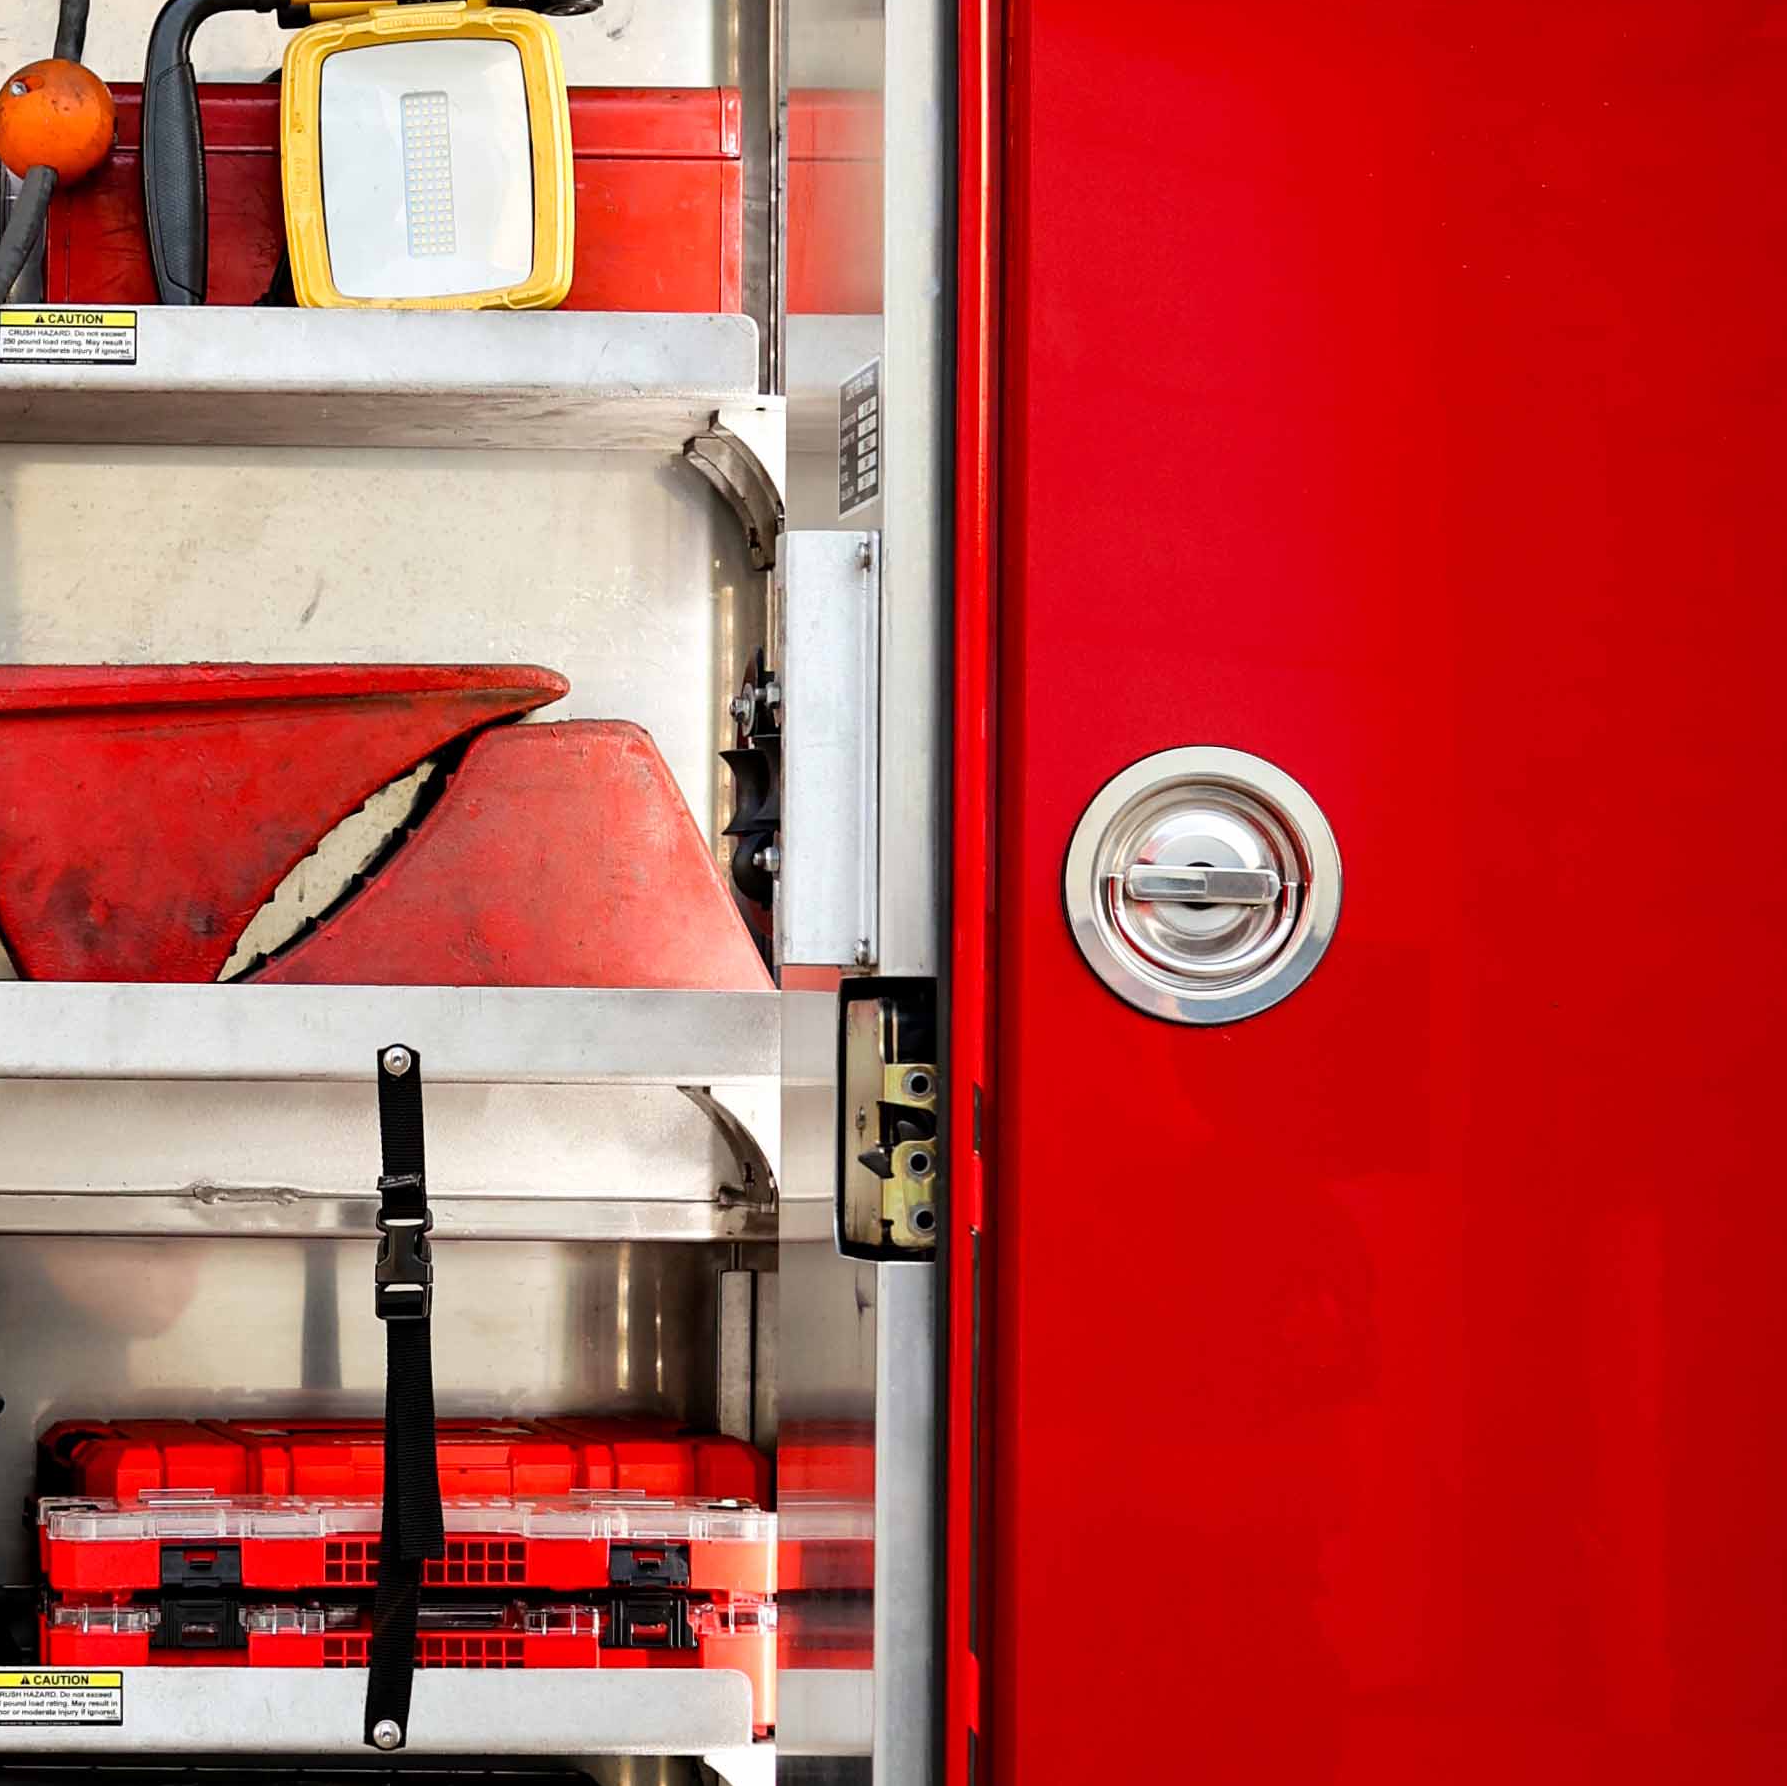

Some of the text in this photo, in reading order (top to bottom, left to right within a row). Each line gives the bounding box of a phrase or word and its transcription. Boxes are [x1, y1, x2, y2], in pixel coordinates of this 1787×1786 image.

[48, 314, 103, 324] CAUTION
[8, 329, 36, 337] CRUSH
[72, 347, 92, 355] injury
[33, 1675, 89, 1685] CAUTION
[3, 1700, 26, 1708] pound
[46, 1700, 69, 1708] rating.
[71, 1700, 86, 1708] May
[58, 1709, 78, 1717] injury
[87, 1709, 117, 1717] ignored.
